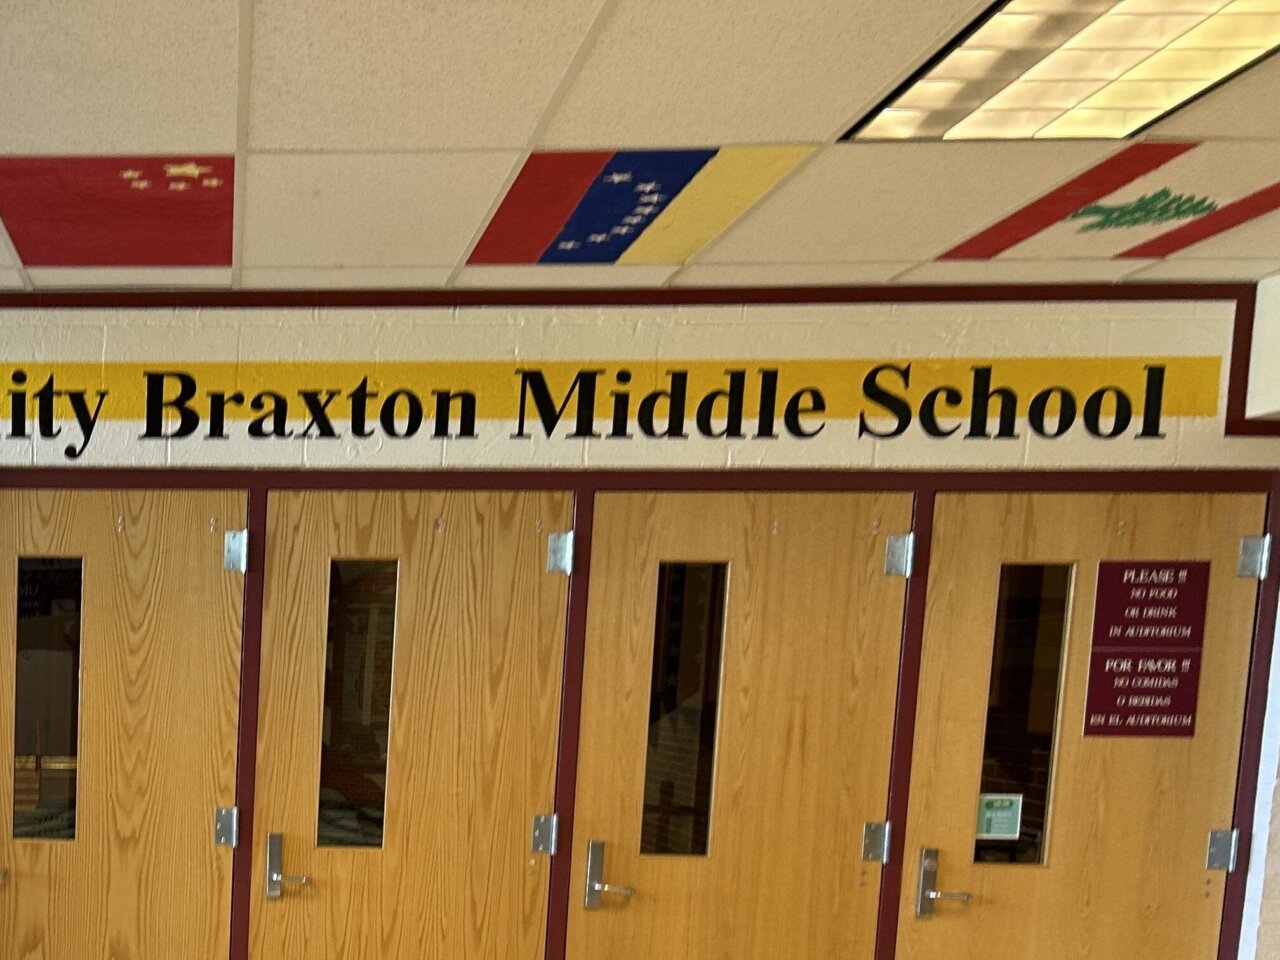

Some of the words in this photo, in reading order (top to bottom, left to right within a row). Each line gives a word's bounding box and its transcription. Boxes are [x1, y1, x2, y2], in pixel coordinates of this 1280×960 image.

[137, 369, 480, 441] Braxton
[508, 367, 827, 441] Middle
[857, 361, 1168, 441] School
[1123, 568, 1175, 584] PLEASE
[1130, 587, 1146, 600] NO
[1148, 587, 1179, 600] FOOD
[1124, 606, 1140, 619] OR
[1142, 606, 1178, 619] DRINK
[1109, 625, 1121, 638] IN
[1124, 625, 1192, 638] AUDITORIUM
[1104, 658, 1132, 673] POR
[1137, 658, 1177, 673] FAVOR
[1113, 676, 1129, 689] NO
[1131, 676, 1179, 689] COMIDAS
[1089, 714, 1105, 727] EN
[1108, 714, 1122, 727] EL
[1125, 714, 1192, 727] AUDITORIUM
